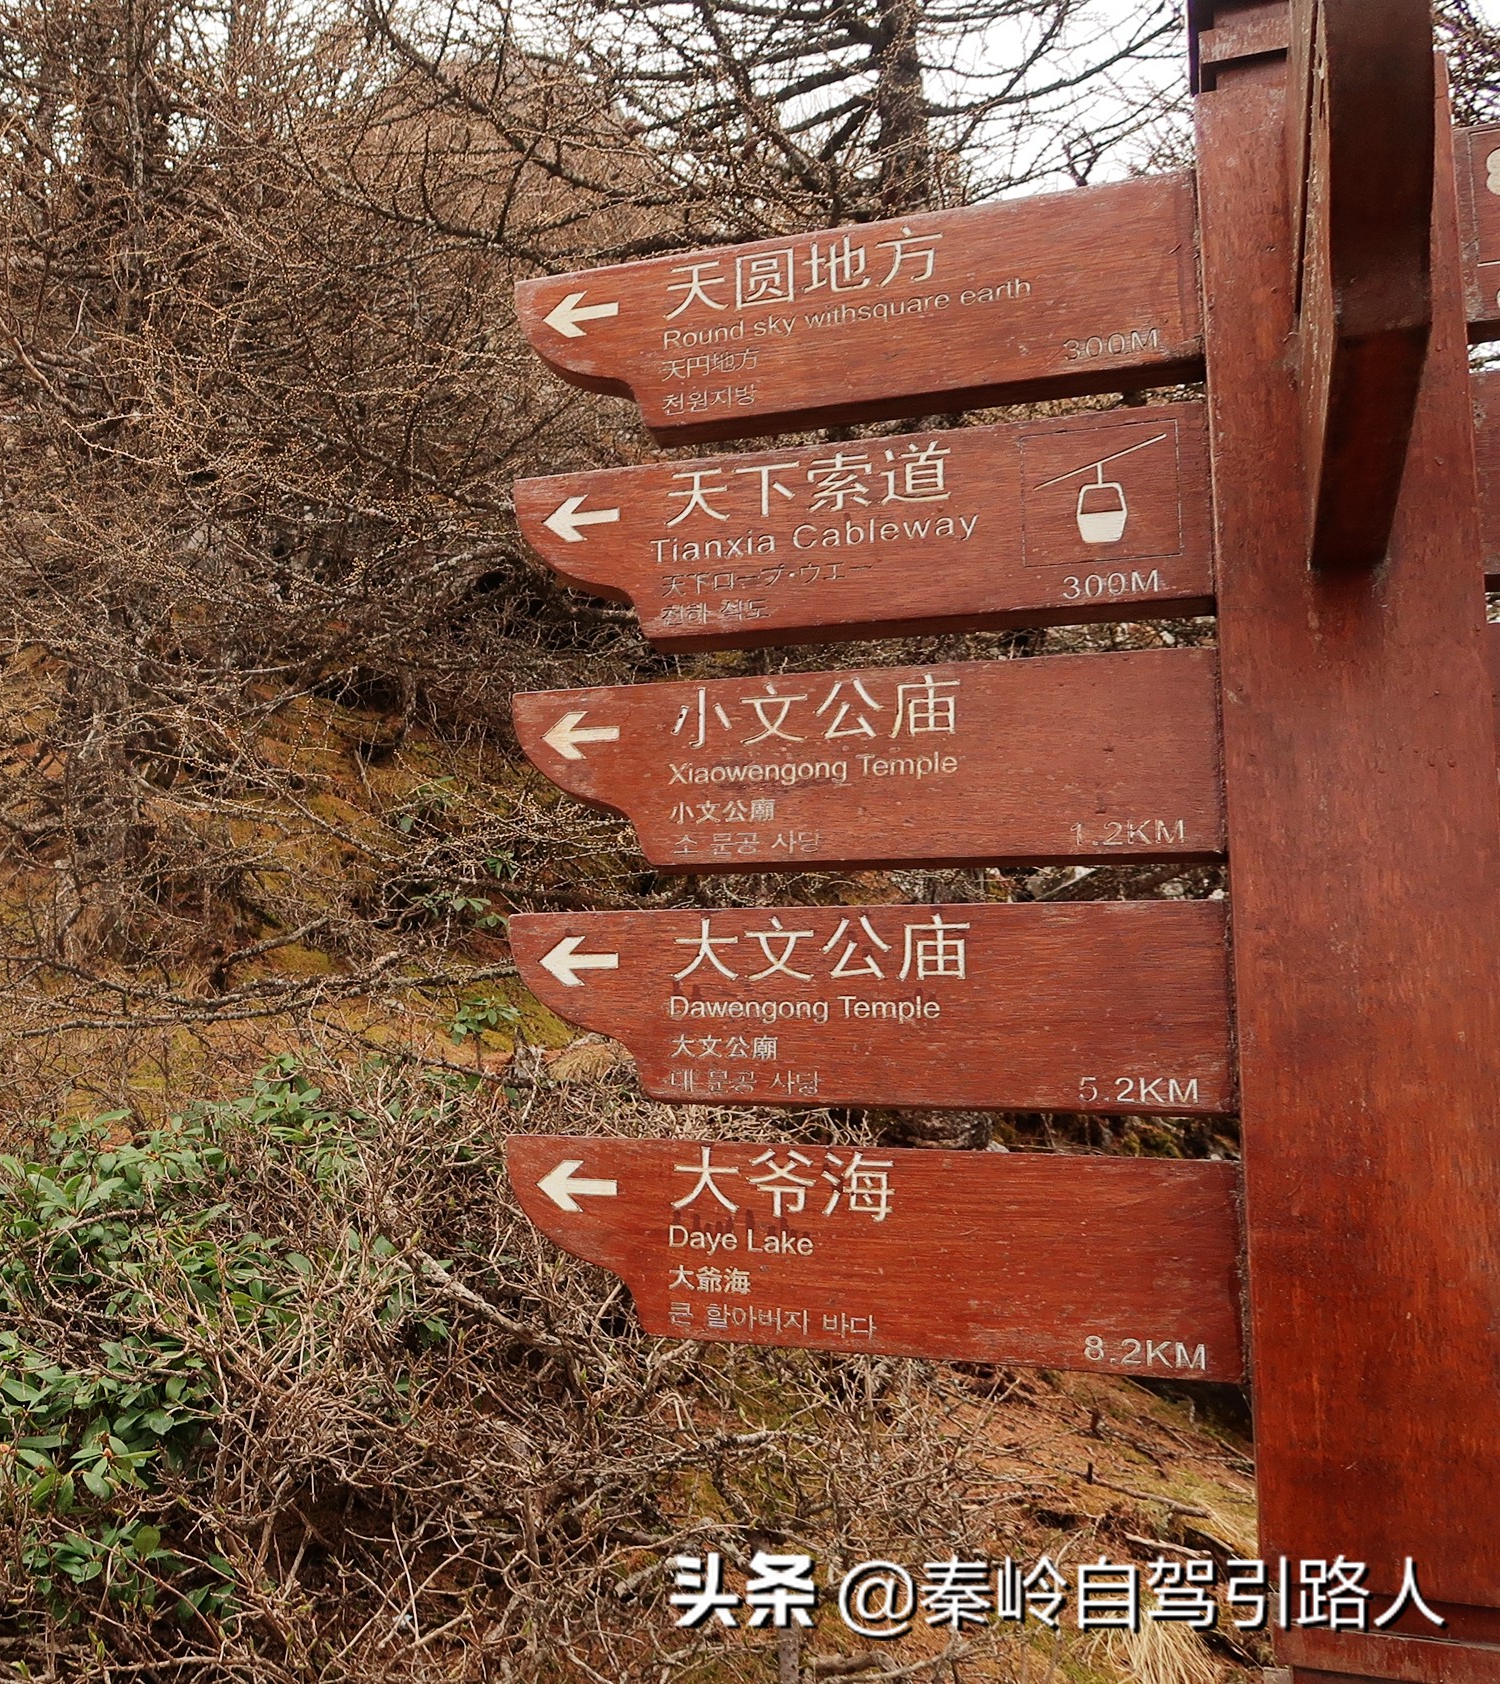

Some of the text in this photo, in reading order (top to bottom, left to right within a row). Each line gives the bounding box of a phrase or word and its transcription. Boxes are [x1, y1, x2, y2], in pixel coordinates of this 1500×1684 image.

[663, 227, 944, 320] 天圆地方
[662, 276, 1032, 350] Round sky withsquare earth
[1063, 328, 1159, 361] 300M
[661, 346, 760, 382] 天円地方
[662, 384, 757, 416] 천원지방
[664, 440, 951, 528] 天下索道
[650, 513, 979, 564] Tianxia Cableway
[1061, 568, 1160, 600] 300M
[661, 602, 710, 627] 천하
[670, 673, 961, 749] 小文公庙
[668, 751, 959, 786] Xiaowengong Temple
[668, 797, 777, 826] 小文公廟
[673, 828, 822, 856] 소 문공 사당
[1069, 819, 1185, 847] 1.2KM
[669, 913, 971, 982] 大文公庙
[668, 994, 941, 1024] Dawengong Temple
[669, 1033, 779, 1061] 大文公廟
[669, 1068, 822, 1096] 대 문공 사당
[1078, 1075, 1199, 1104] 5.2KM
[670, 1146, 896, 1222] 大爷海
[668, 1224, 815, 1257] Daye Lake
[667, 1264, 752, 1295] 大爺海
[667, 1301, 878, 1341] 큰 할아버지 바다
[1083, 1335, 1207, 1371] 8.2KM
